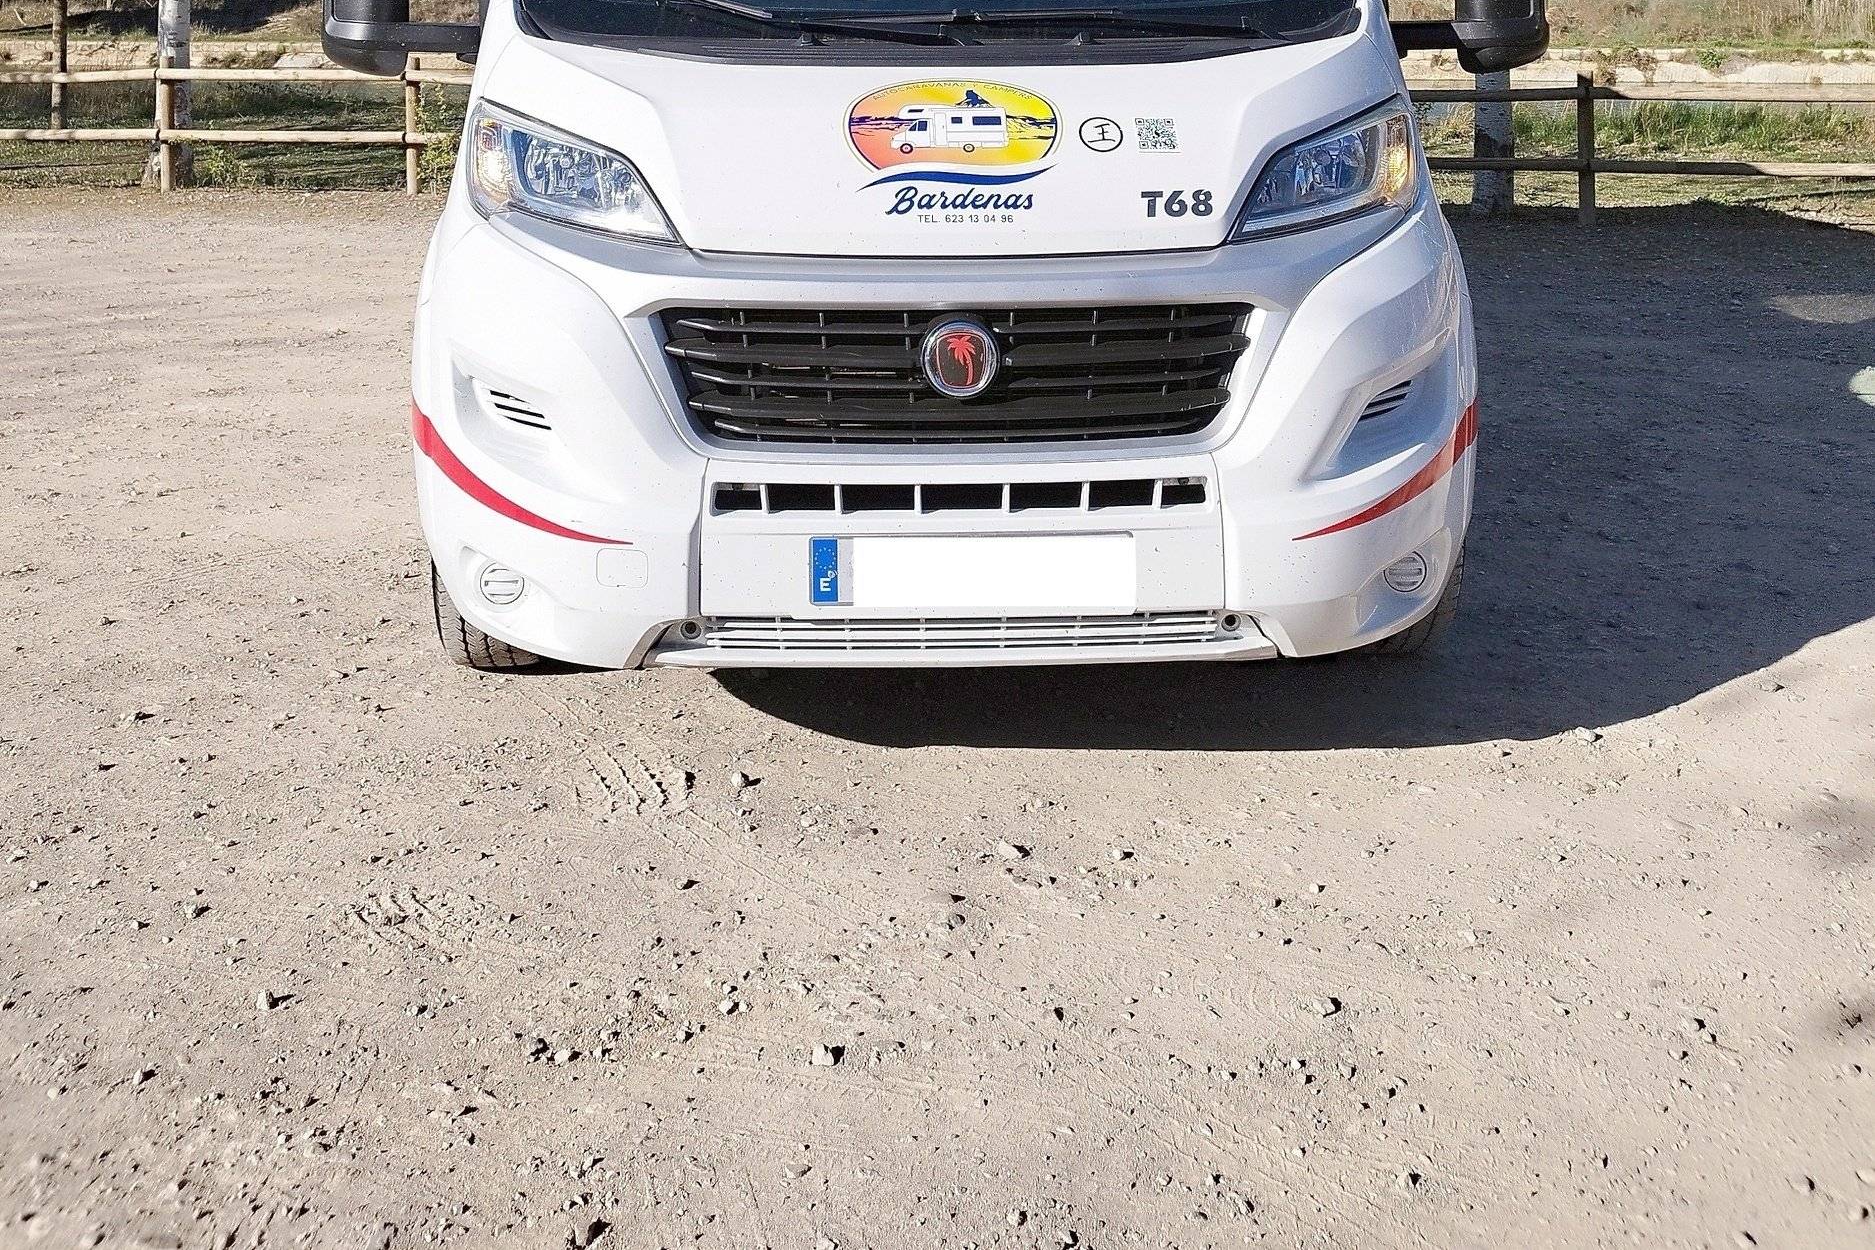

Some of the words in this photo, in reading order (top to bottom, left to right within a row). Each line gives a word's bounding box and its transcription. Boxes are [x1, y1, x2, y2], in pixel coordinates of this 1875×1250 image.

[885, 186, 1034, 215] Bardenas
[1141, 189, 1213, 218] T68
[917, 214, 941, 223] TEL.
[945, 214, 964, 223] 623
[968, 214, 980, 223] 13
[983, 214, 996, 223] 04
[1000, 214, 1014, 223] 96
[819, 577, 832, 592] E
